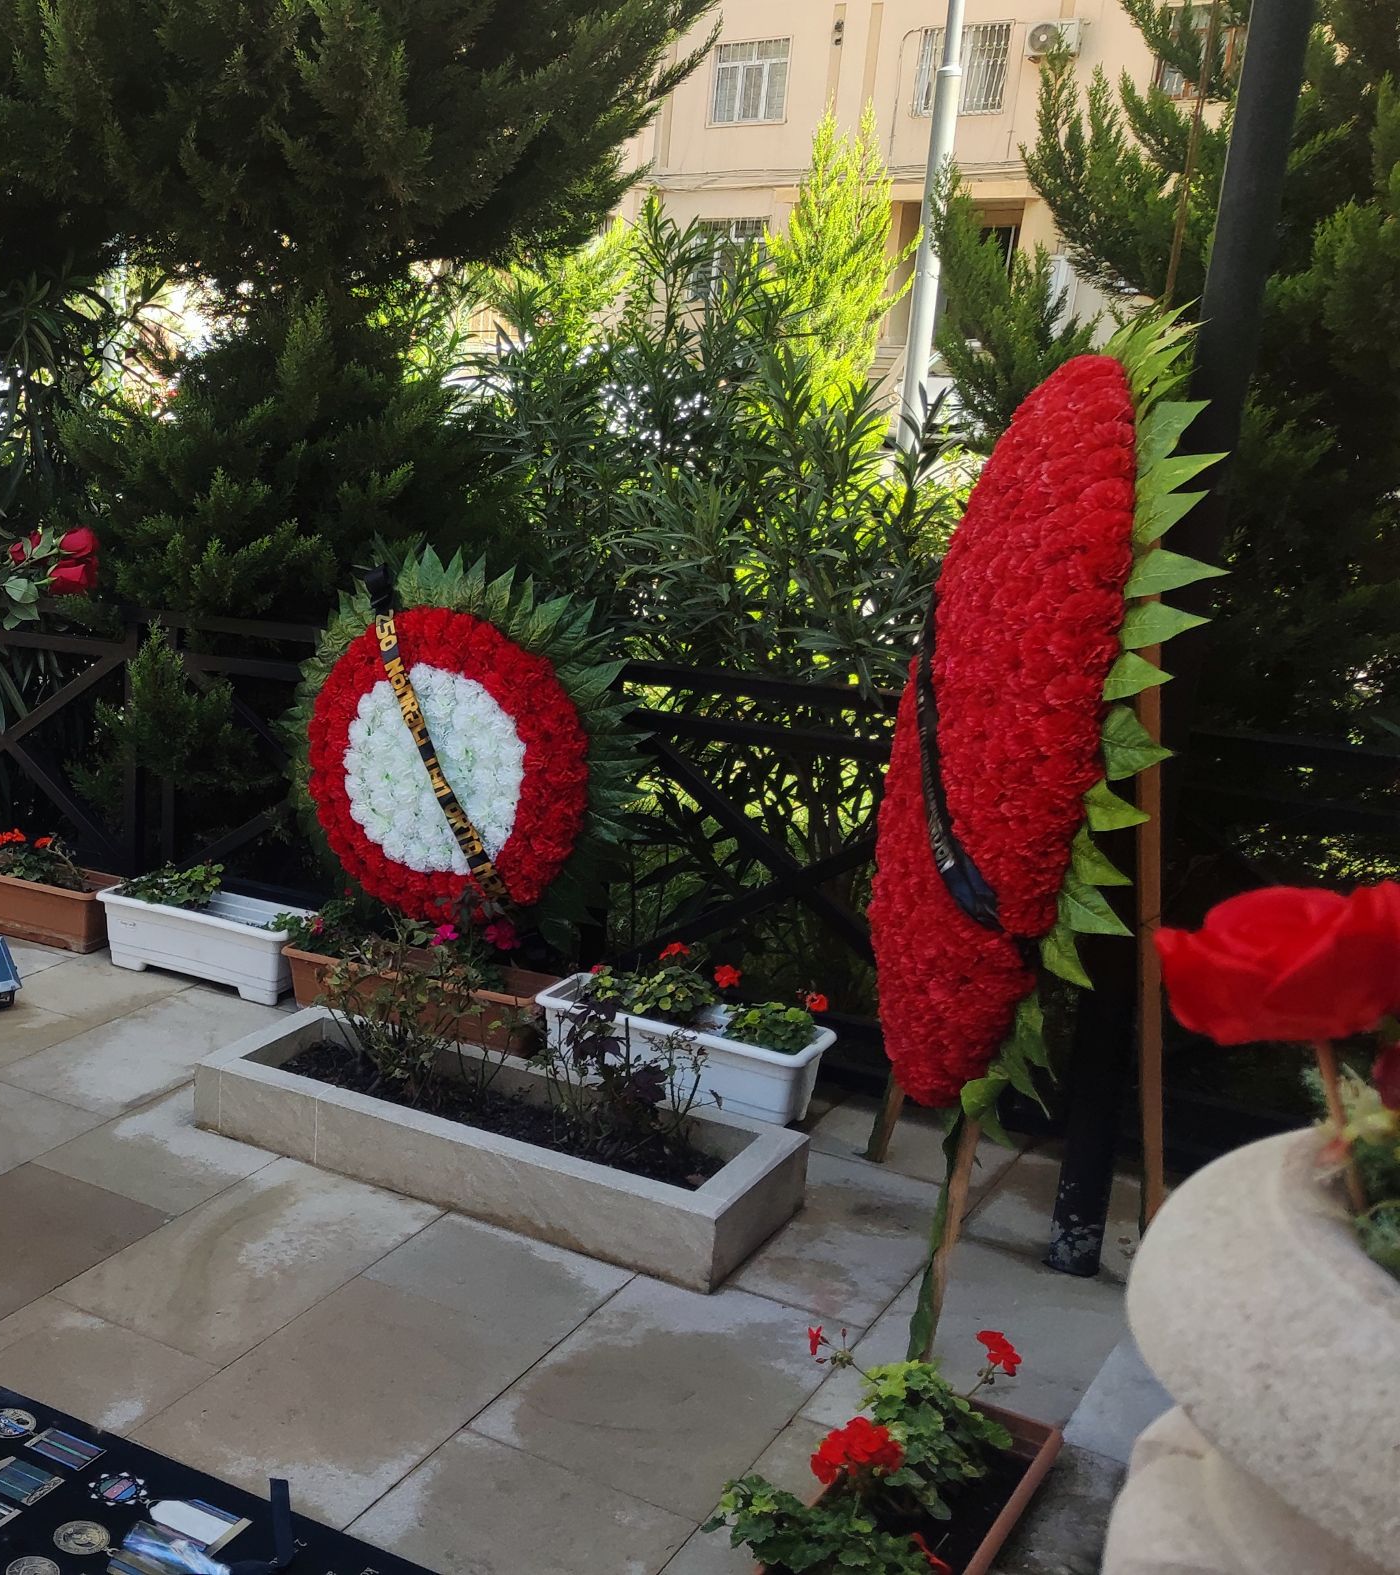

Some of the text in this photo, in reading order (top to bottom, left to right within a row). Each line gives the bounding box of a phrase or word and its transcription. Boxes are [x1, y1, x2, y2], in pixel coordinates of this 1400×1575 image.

[375, 609, 398, 652] 250
[425, 757, 452, 798] TAM
[444, 801, 483, 858] ORTA
